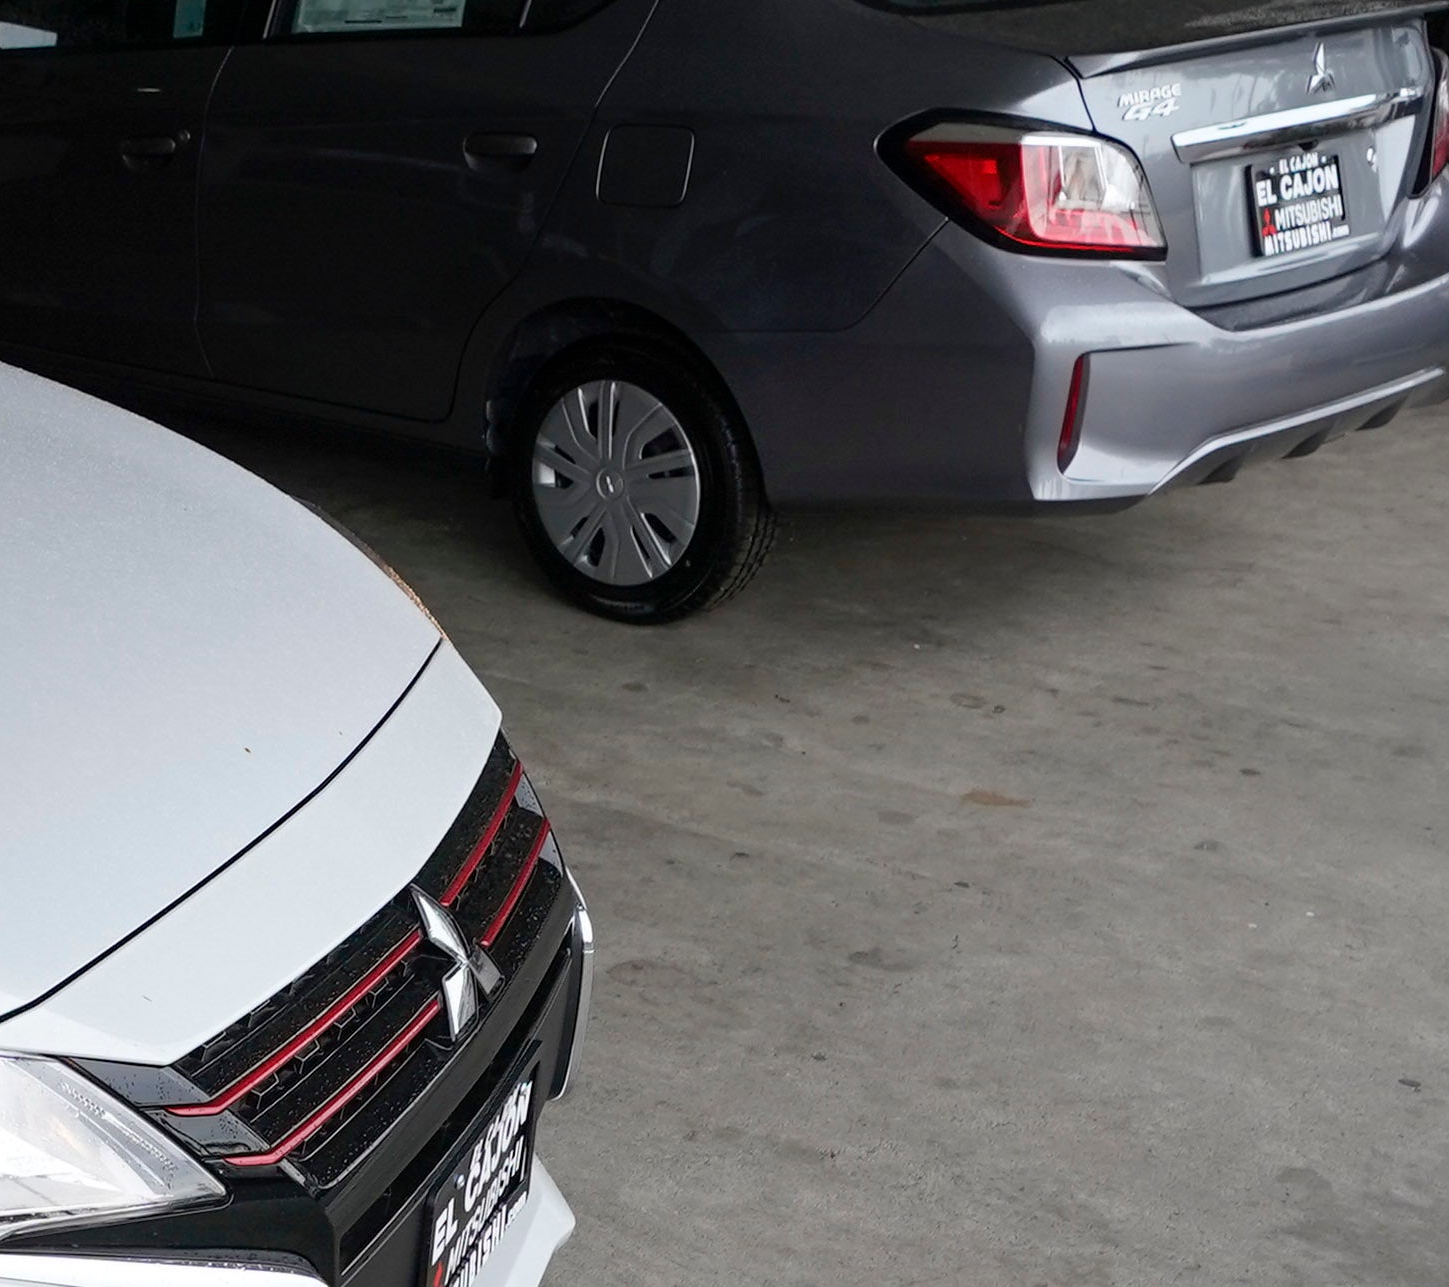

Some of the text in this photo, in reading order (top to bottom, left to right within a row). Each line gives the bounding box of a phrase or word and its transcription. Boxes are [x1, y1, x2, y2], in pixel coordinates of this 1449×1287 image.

[1117, 83, 1181, 107] MIRAGE
[1122, 97, 1179, 120] G4
[1256, 164, 1339, 206] EL CAJON
[1275, 194, 1343, 230] MITSUBISHI
[432, 1081, 532, 1266] EL CAJON
[444, 1135, 524, 1287] MITSUBISHI
